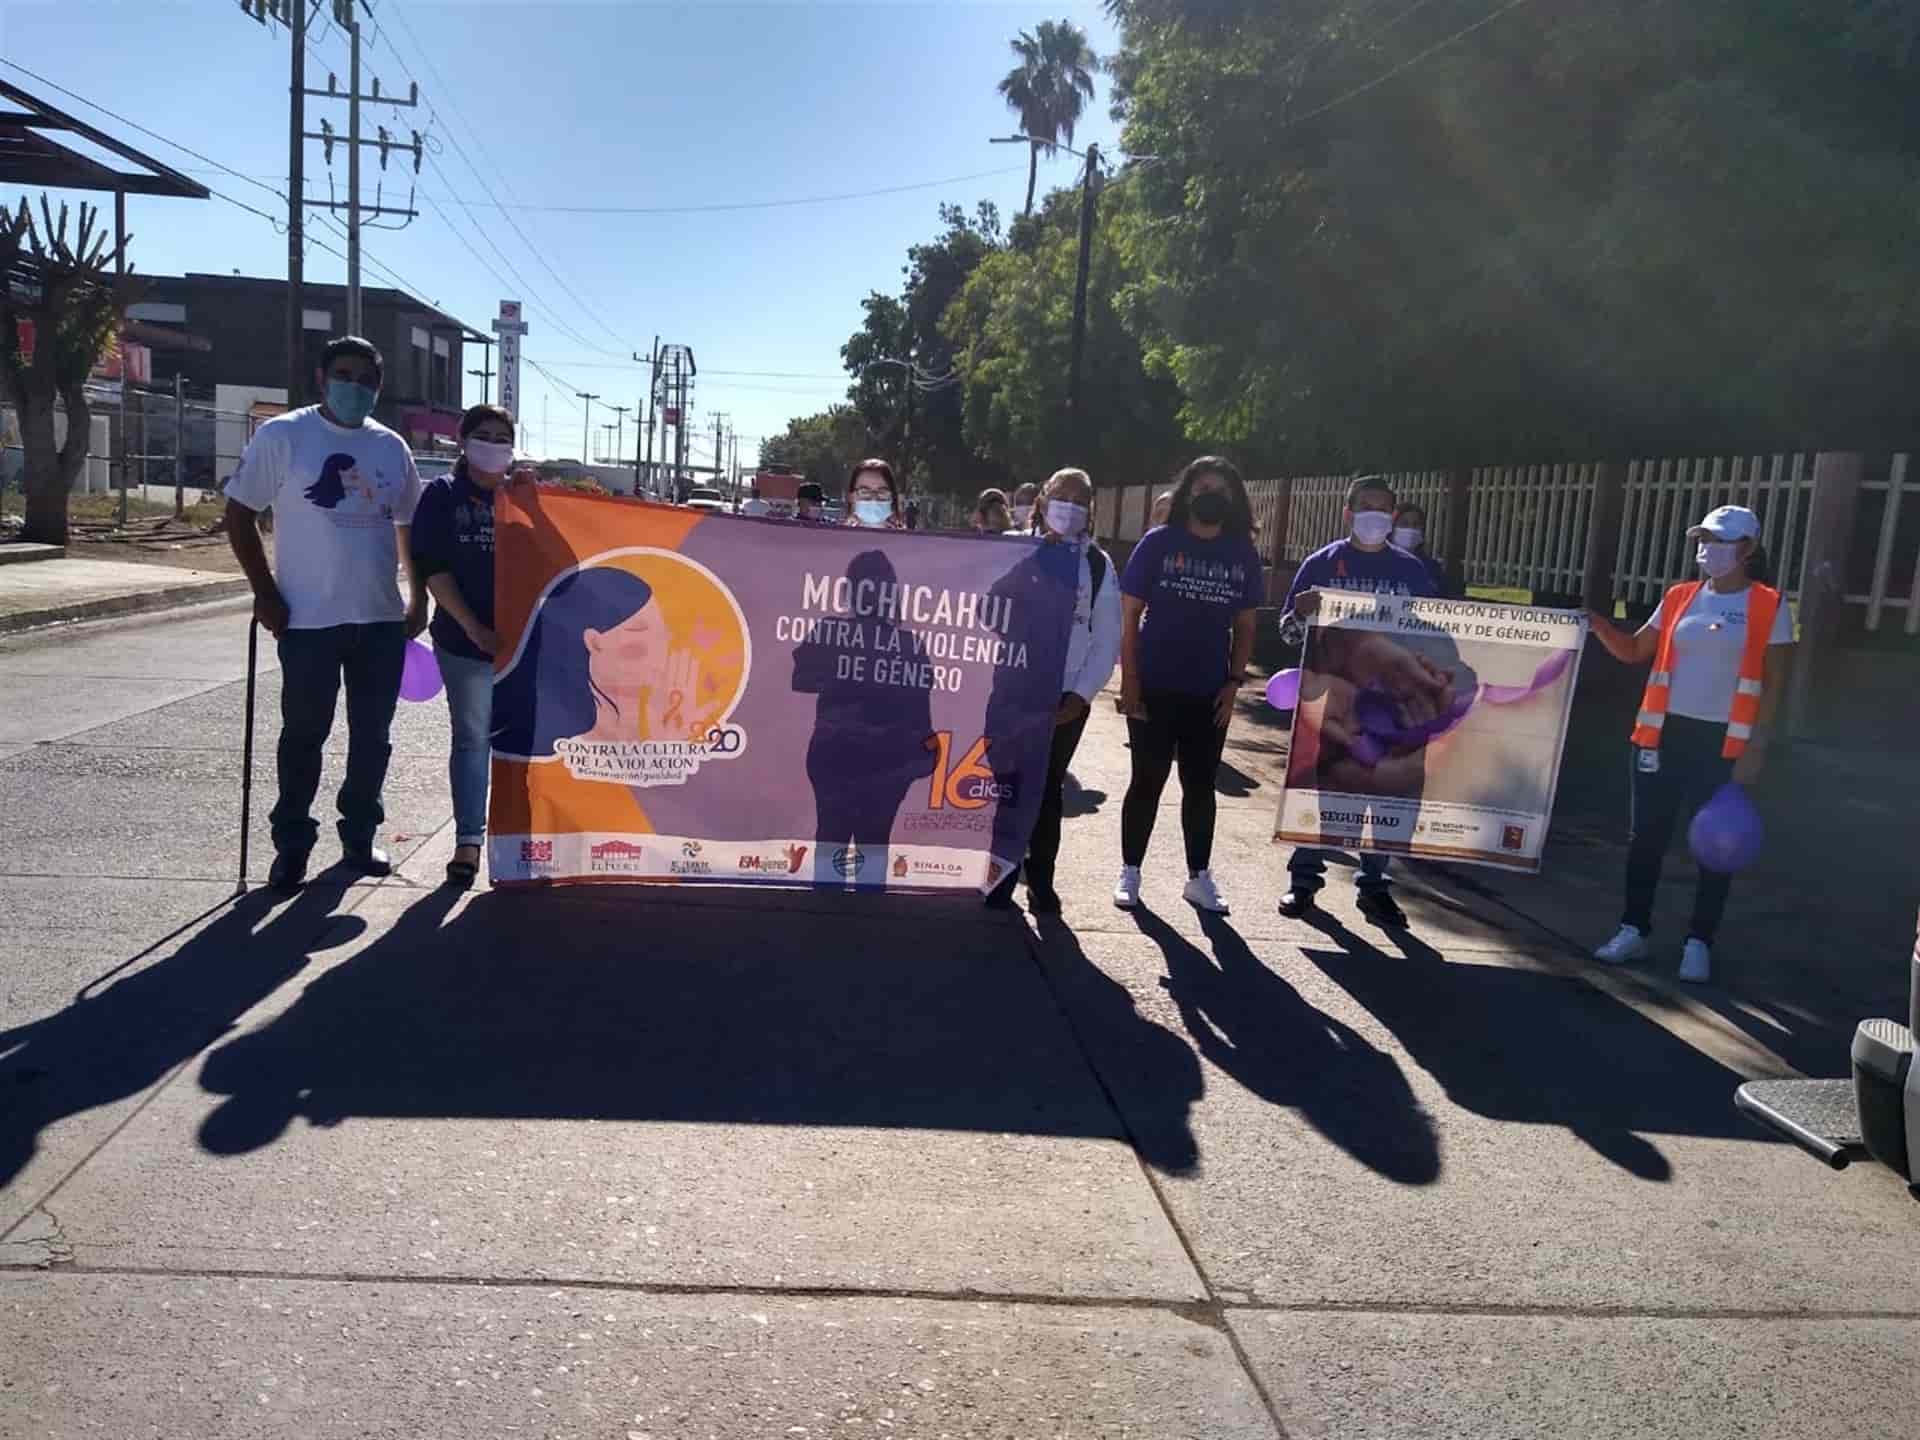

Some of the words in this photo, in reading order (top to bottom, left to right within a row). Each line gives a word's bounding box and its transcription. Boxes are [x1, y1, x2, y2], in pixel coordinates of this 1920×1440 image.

[801, 572, 1013, 634] MOCHICAHUI
[1402, 600, 1485, 617] PREVENCIÓN
[1489, 608, 1505, 620] DE
[1511, 609, 1580, 626] VIOLENCIA
[776, 615, 865, 649] CONTRA
[874, 625, 900, 652] LA
[911, 629, 1028, 669] VIOLENCIA
[1398, 618, 1460, 633] FAMILIAR
[1465, 624, 1473, 634] Y
[1475, 625, 1492, 637] DE
[1496, 623, 1550, 642] GÉNERO
[836, 655, 866, 682] DE
[874, 656, 963, 693] GÉNERO
[557, 742, 617, 756] CONTRA
[622, 743, 642, 756] LA
[570, 755, 586, 767] DE
[594, 757, 613, 769] LA
[920, 730, 992, 810] 16
[1320, 810, 1400, 828] SEGURIDAD
[914, 861, 963, 872] SINALOA
